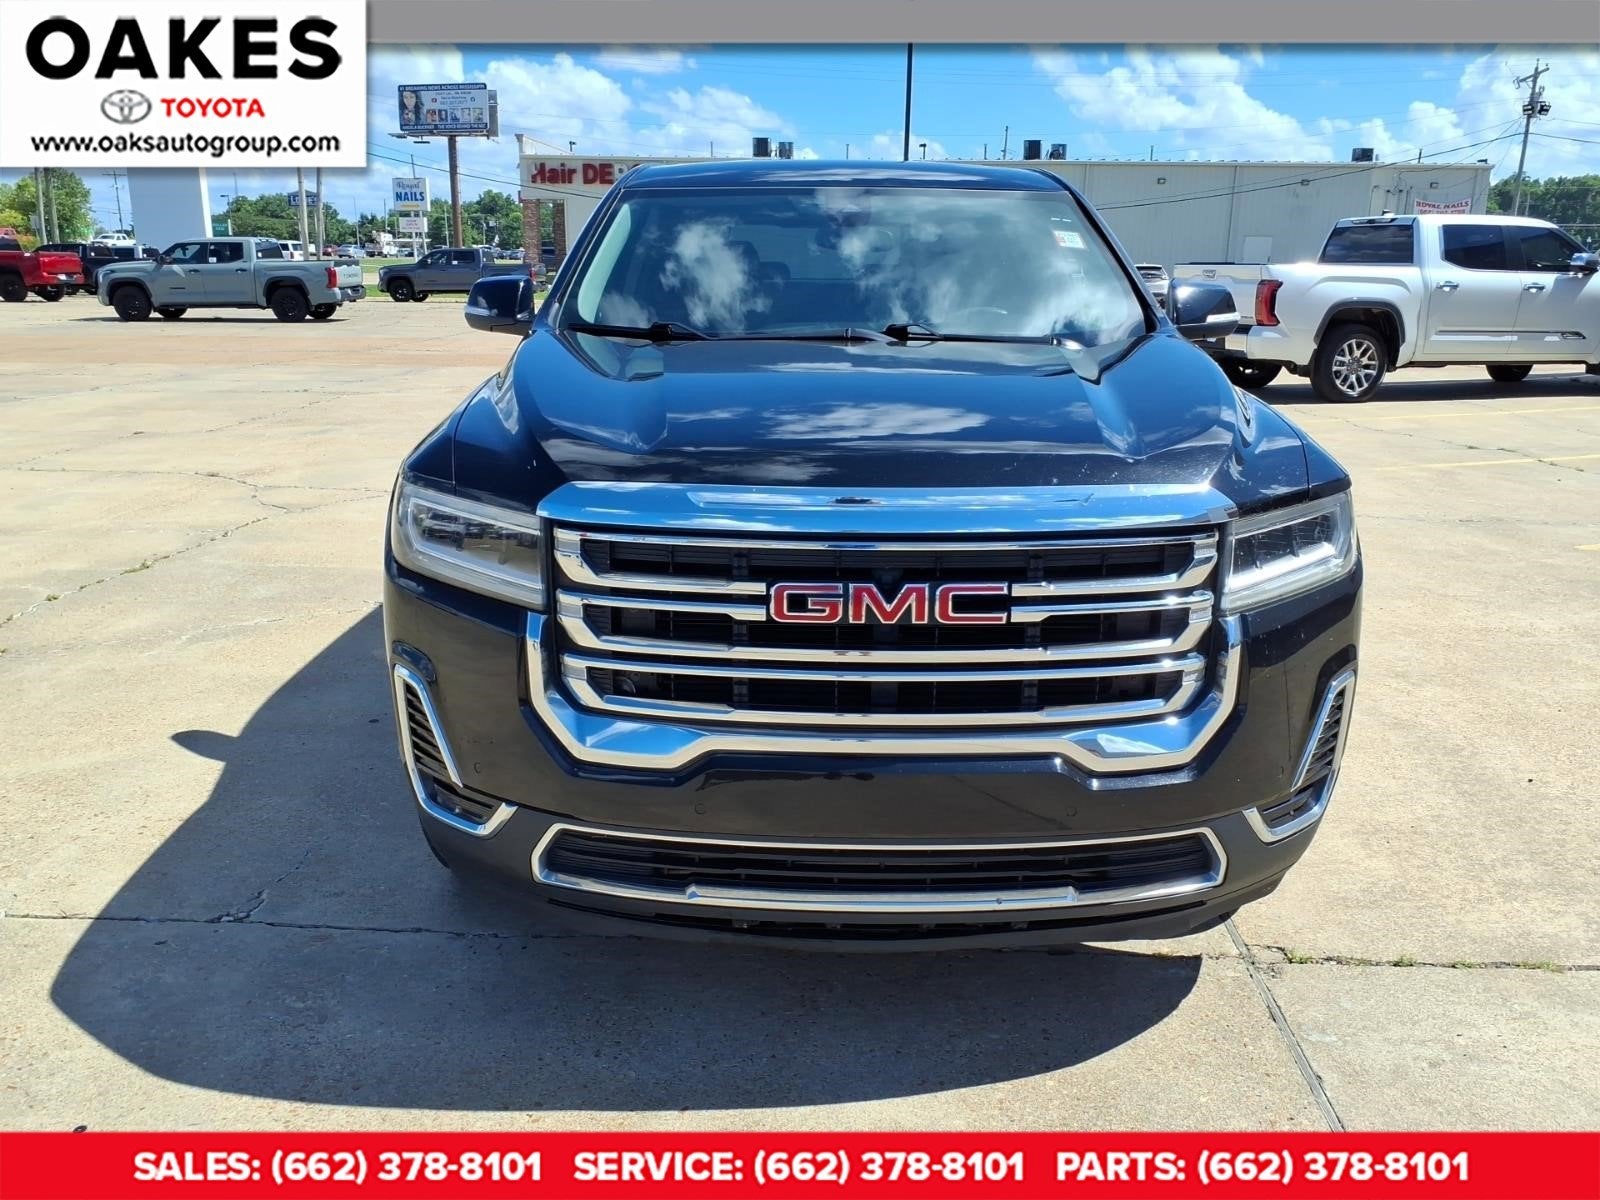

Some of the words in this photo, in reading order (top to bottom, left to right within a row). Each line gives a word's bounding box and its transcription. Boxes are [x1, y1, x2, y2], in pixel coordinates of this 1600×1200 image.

[531, 162, 577, 184] Hair
[395, 191, 425, 202] NAILS
[1443, 201, 1469, 209] NAILS
[768, 581, 1009, 624] GMC
